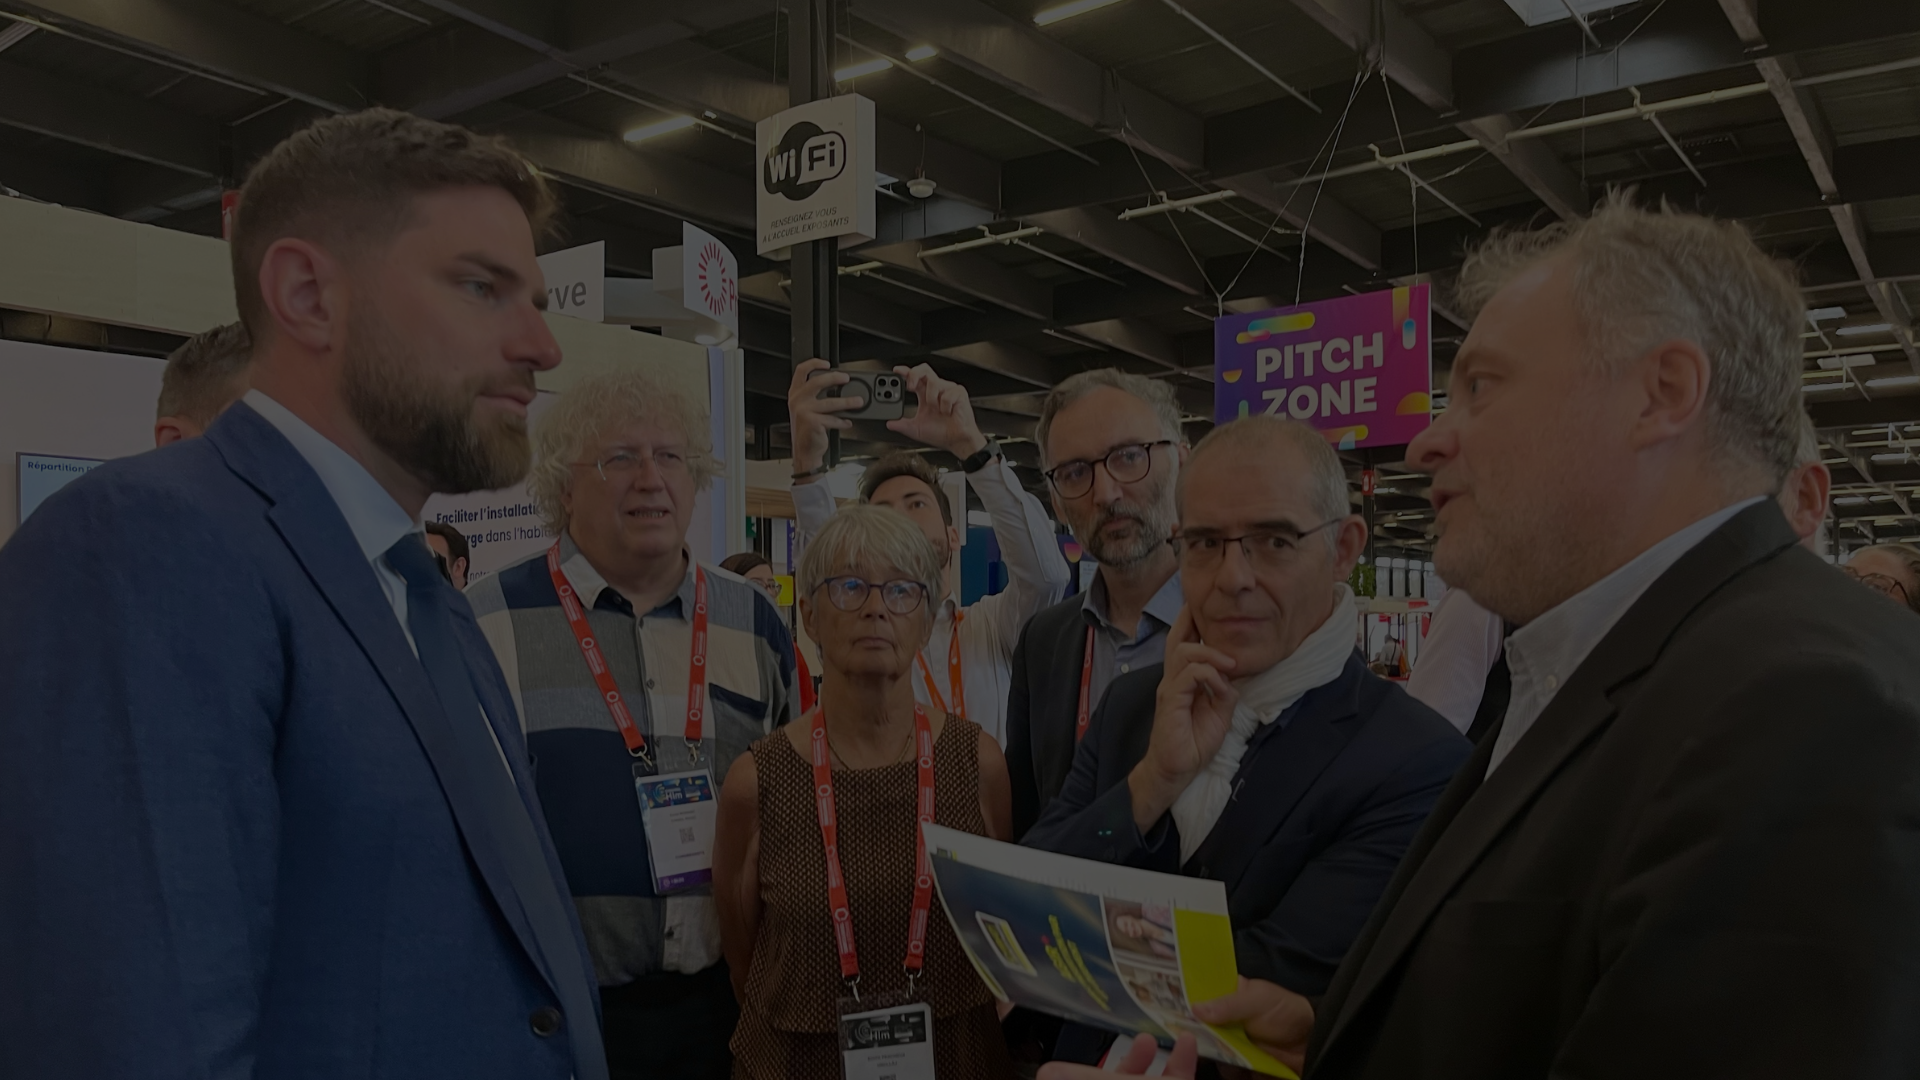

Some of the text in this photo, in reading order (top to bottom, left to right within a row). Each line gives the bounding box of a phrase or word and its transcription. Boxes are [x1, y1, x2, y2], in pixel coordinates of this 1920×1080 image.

[767, 226, 800, 242] L'ACCUEIL
[802, 216, 850, 233] EXPOSANTS
[770, 206, 837, 230] RENSEIGNEZ VOUS
[1256, 331, 1384, 383] PITCH
[1262, 376, 1378, 421] ZONE
[27, 461, 85, 473] Répartition
[436, 508, 479, 524] Faciliter
[486, 529, 511, 543] dans
